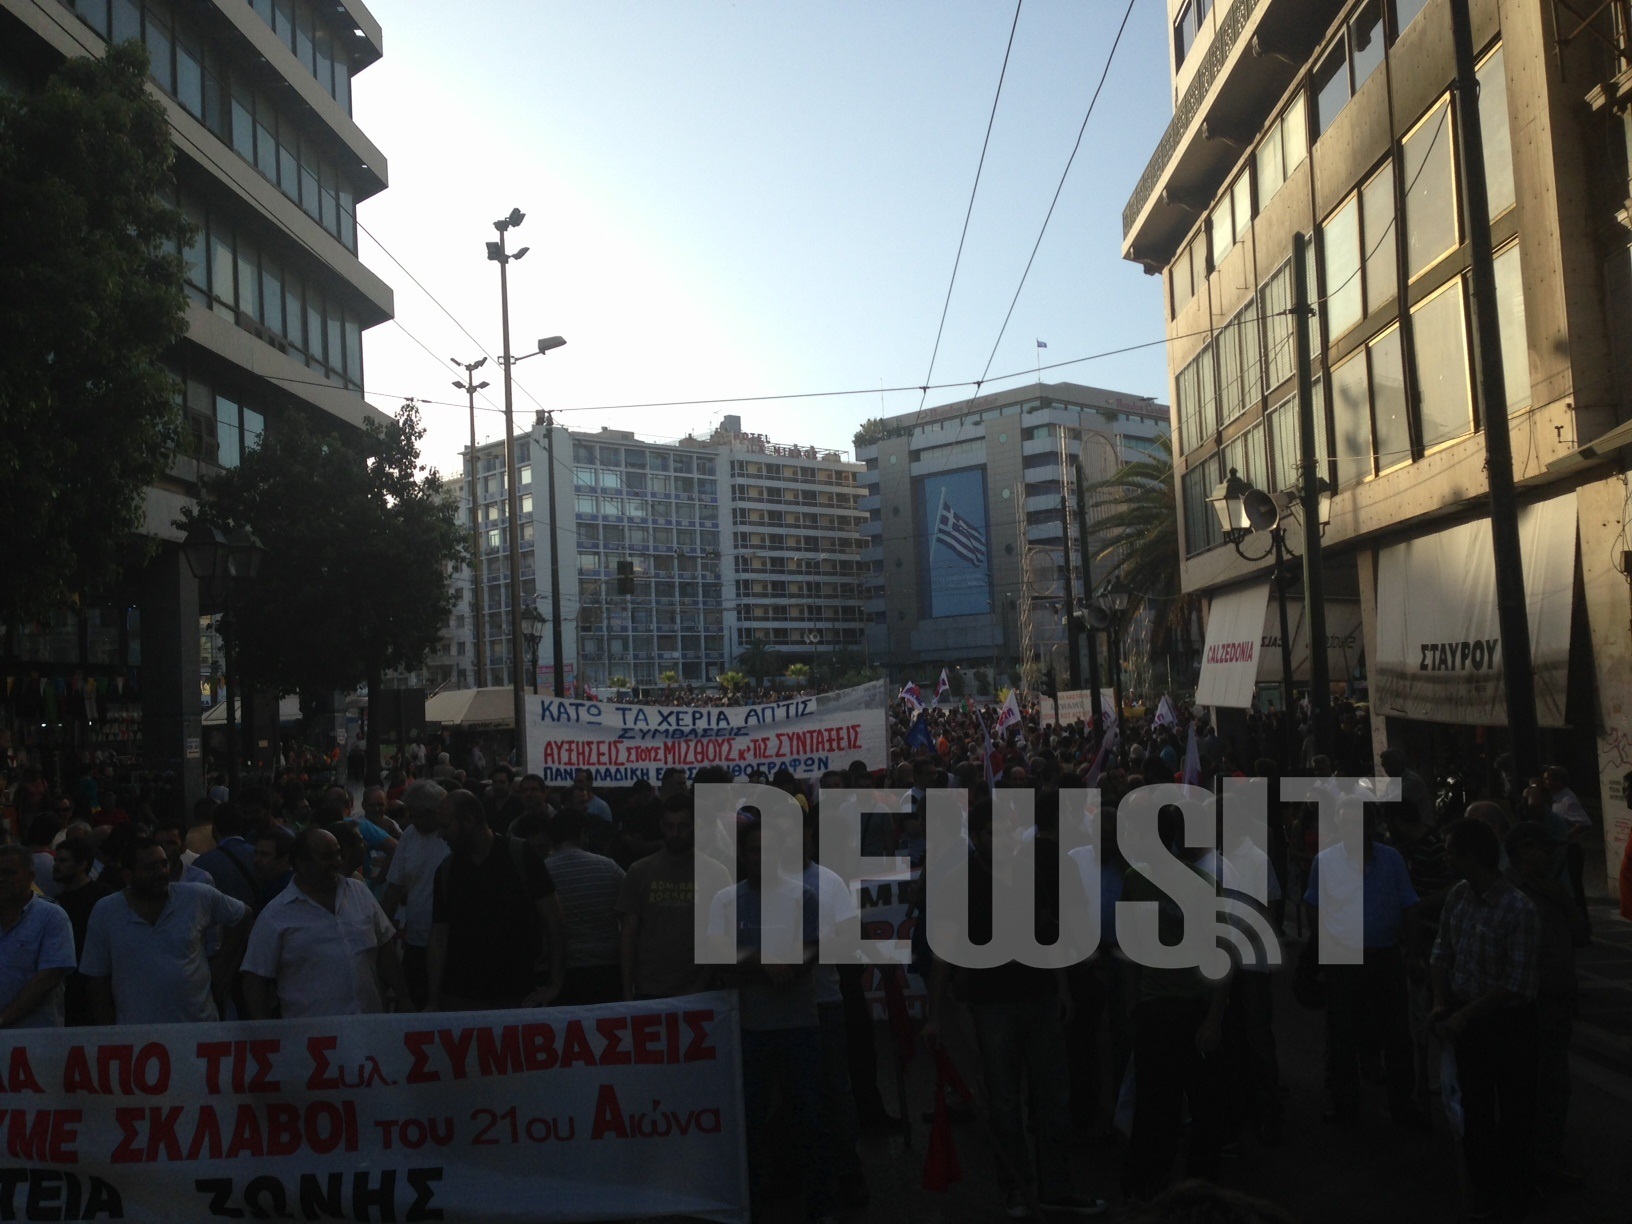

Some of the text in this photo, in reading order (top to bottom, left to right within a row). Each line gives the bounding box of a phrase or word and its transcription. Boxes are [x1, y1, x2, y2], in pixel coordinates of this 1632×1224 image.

[1207, 641, 1254, 664] CALZEDONIA
[1420, 639, 1499, 671] ΣΤΑΥΡΟΥ
[541, 700, 602, 724] ΚΑΤΩ
[615, 707, 649, 725] ΤΑ
[657, 709, 730, 727] ΧΕΡΙΑ
[543, 740, 625, 766] ΑΥΞΗΣΕΙΣ
[626, 745, 662, 763] ΣΤΟΥΣ
[663, 737, 737, 765] ΜΙΣΘΟΥΣ
[775, 724, 863, 758] ΣΥΝΤΑΞΕΙΣ
[618, 726, 749, 740] ΣΥΜΒΑΣΕΙΣ
[543, 767, 650, 782] ΠΑΝΛΑΔΙΚΗ
[64, 1041, 172, 1096] ΑΠΟ
[196, 1038, 281, 1096] ΤΙΣ
[403, 1009, 717, 1085] ΣΥΜΒΑΣΕΙΣ
[110, 1100, 359, 1164] ΣΚΛΑΒΟΙ
[470, 1106, 575, 1147] 21ου
[591, 1084, 722, 1141] Αιώνα
[195, 1167, 445, 1224] ΖΩΝΗΣ
